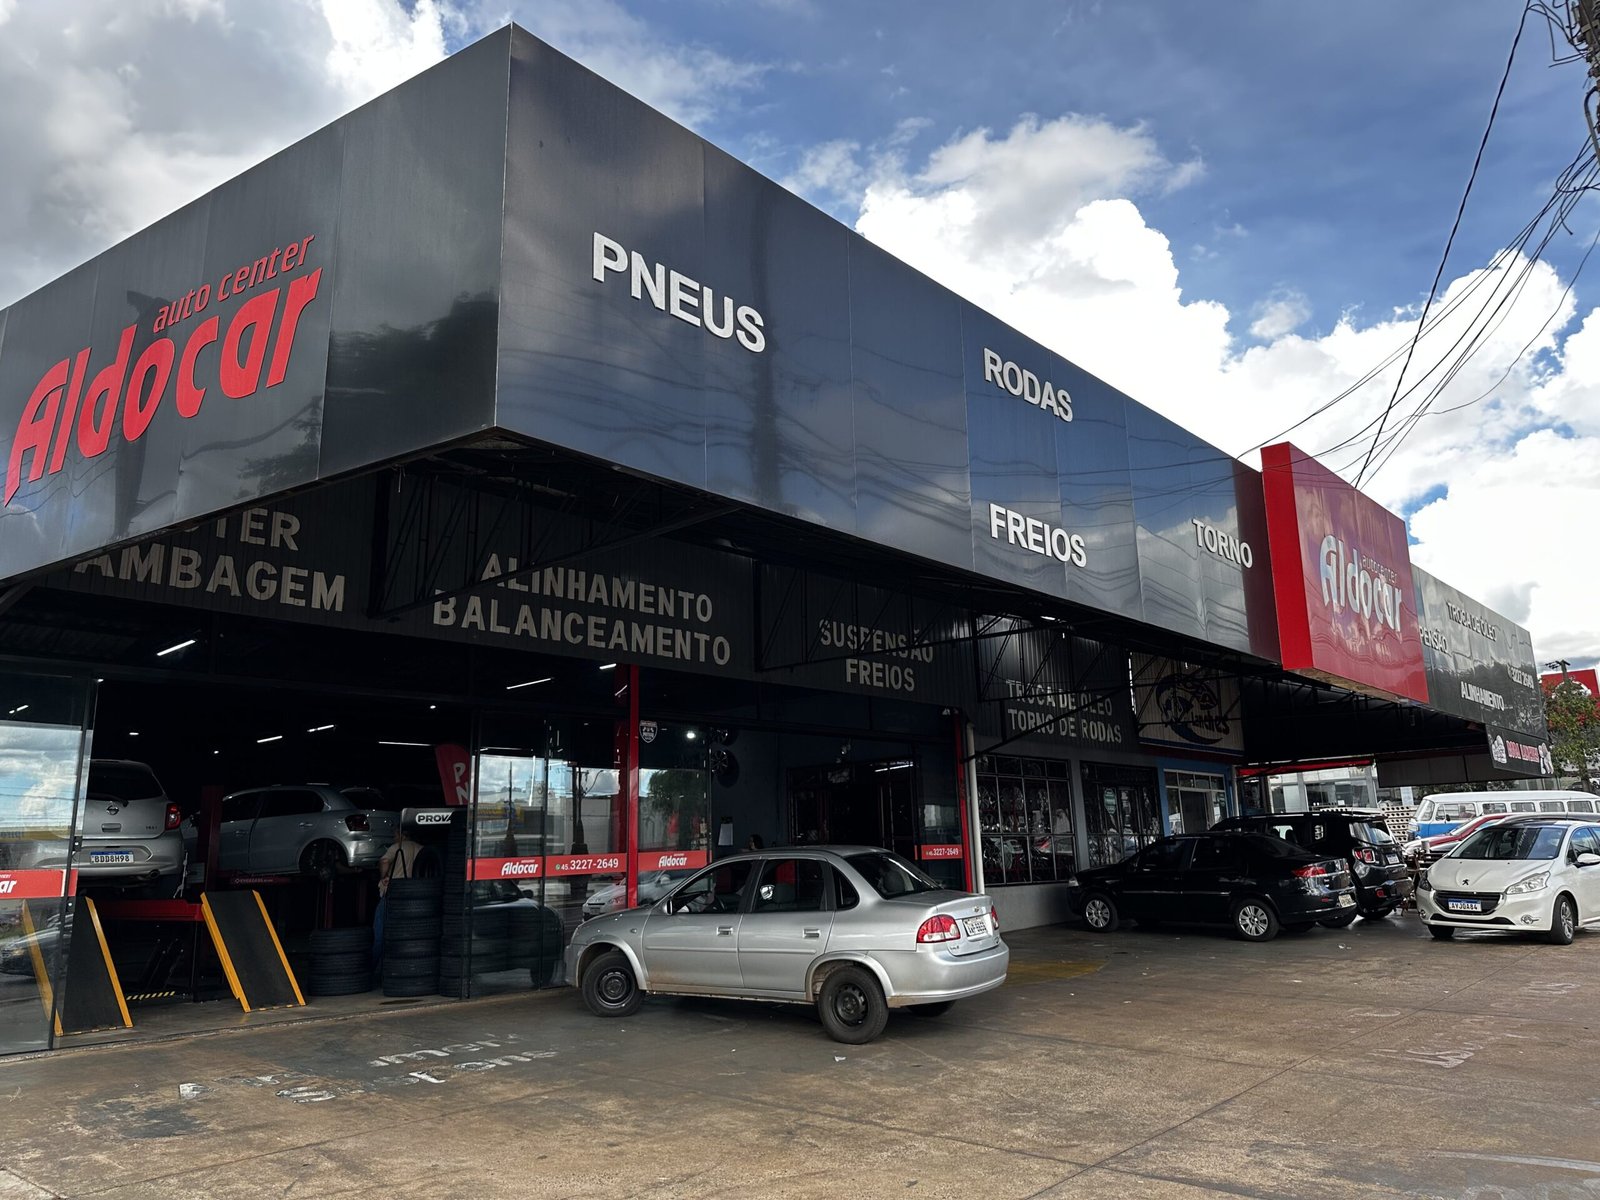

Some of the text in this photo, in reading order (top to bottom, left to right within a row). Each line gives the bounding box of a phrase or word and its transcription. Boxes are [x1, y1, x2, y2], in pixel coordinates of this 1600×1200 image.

[153, 234, 316, 334] auto center
[593, 231, 766, 353] PNEUS
[4, 267, 324, 508] Aldocar
[983, 347, 1074, 423] RODAS
[989, 503, 1087, 568] FREIOS
[1192, 518, 1253, 569] TORNO
[480, 552, 713, 623] ALINHAMENTO
[1320, 534, 1403, 632] Aldocar
[433, 588, 731, 666] BALANCEAMENTO
[818, 617, 934, 664] SUSPENSÃO
[1445, 601, 1471, 630] TROCA
[845, 658, 915, 692] FREIOS
[1058, 688, 1077, 710] DE
[1460, 681, 1505, 712] ALINHAMENTO
[1007, 708, 1122, 744] TORNO DE RODAS
[501, 862, 539, 876] Aldocar
[658, 855, 688, 868] Aldocar
